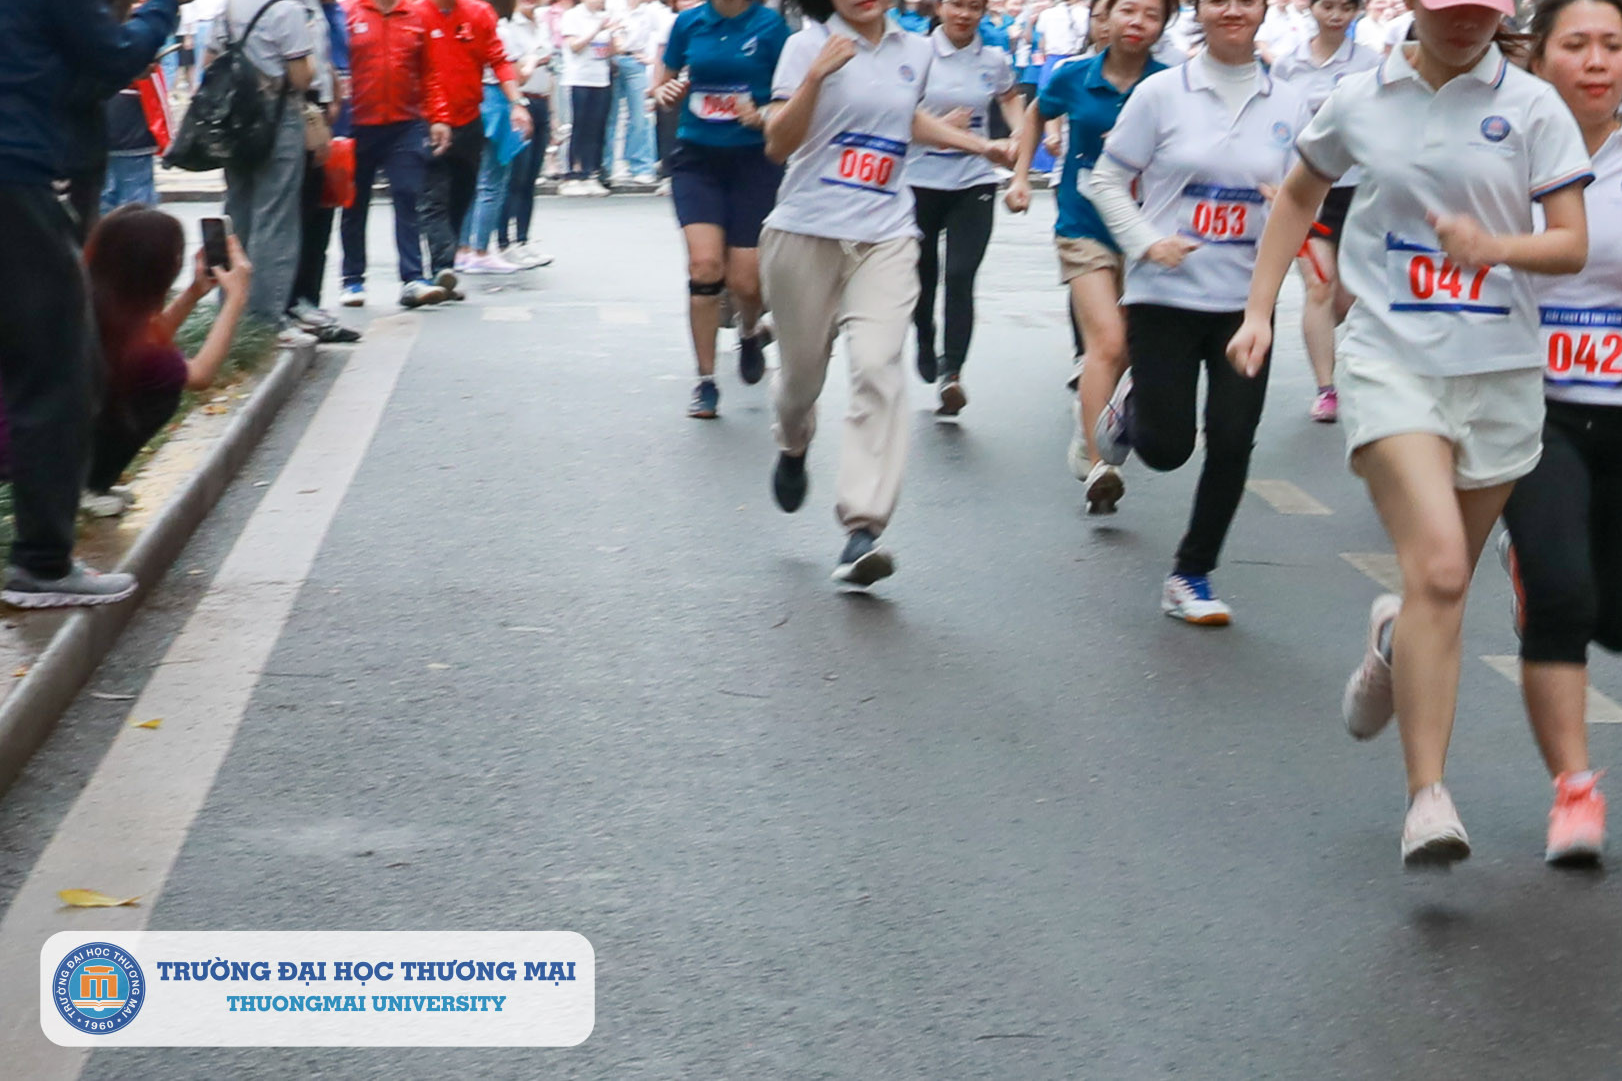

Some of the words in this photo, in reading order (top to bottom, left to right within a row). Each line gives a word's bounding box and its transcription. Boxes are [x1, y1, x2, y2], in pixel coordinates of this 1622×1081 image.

[839, 148, 894, 186] 060
[1193, 201, 1247, 237] 053
[1409, 255, 1491, 300] 047
